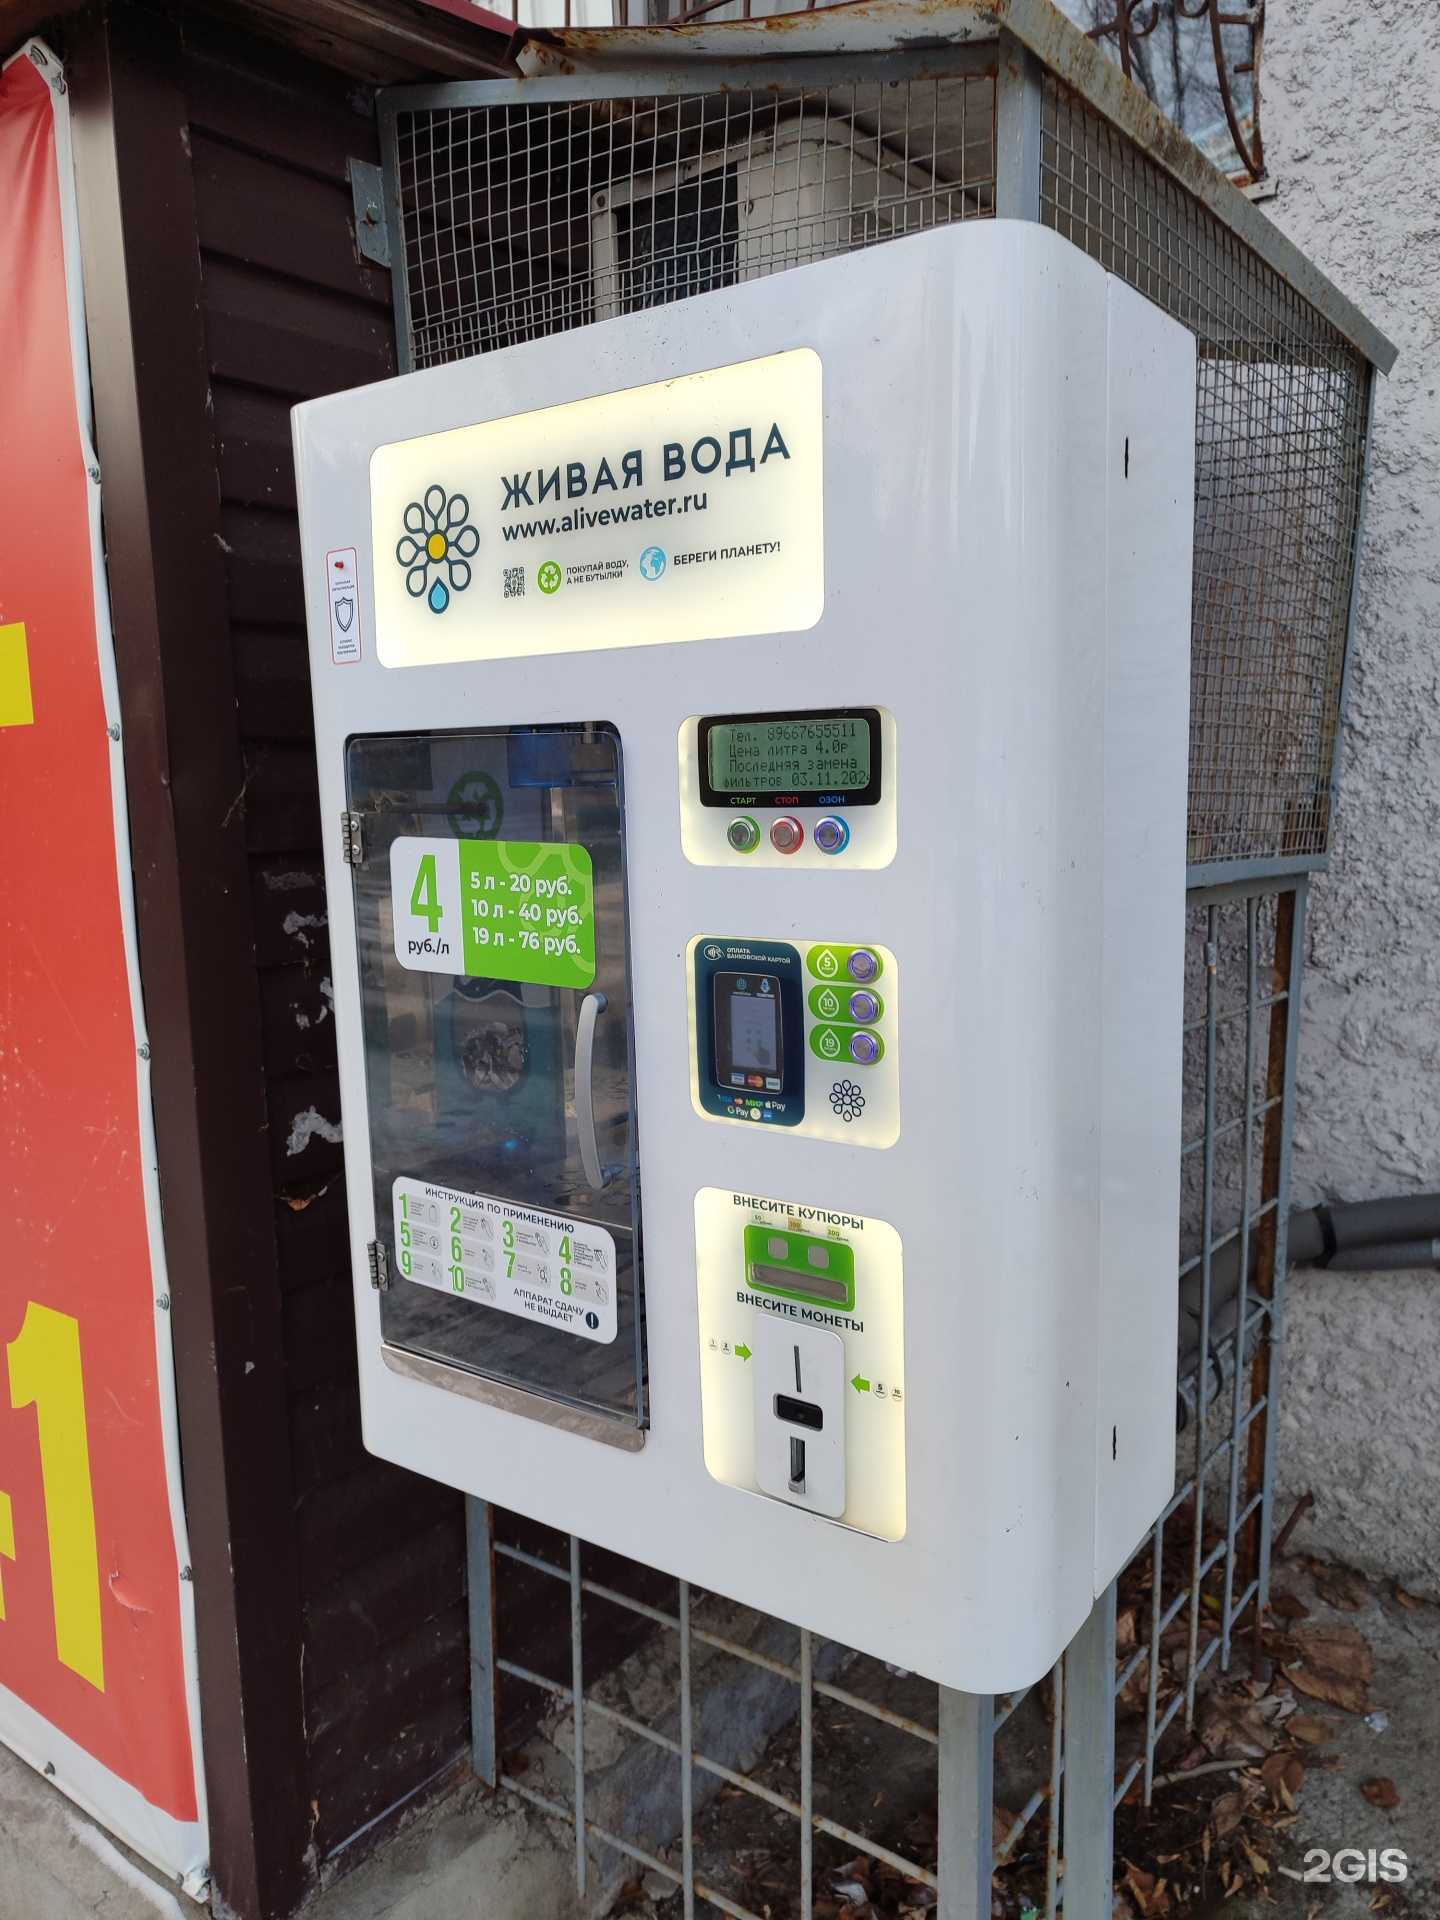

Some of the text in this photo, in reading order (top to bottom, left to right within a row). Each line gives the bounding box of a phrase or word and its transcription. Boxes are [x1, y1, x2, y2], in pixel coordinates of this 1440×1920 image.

[500, 422, 791, 511] ЖИВАЯ ВОДА
[502, 490, 709, 542] www.alivewater.ru
[673, 540, 781, 567] БЕРЕГИ ПЛАНЕТУ!
[566, 559, 629, 575] ПОКУПАЙ ВОДУ,
[566, 570, 623, 585] А НЕ БУТЫЛКИ
[729, 723, 856, 743] Тел. 89667655511
[729, 739, 848, 759] Цена литра 4.0р
[729, 758, 858, 774] Последняя замена
[730, 795, 845, 806] СТАРТ СТОП ОЗОН
[410, 854, 444, 934] 4
[470, 872, 481, 890] 5
[484, 876, 495, 891] л
[509, 874, 531, 893] 20
[535, 875, 572, 898] руб.
[471, 899, 489, 918] 10
[493, 904, 504, 919] л
[518, 903, 542, 922] 40
[546, 905, 583, 928] руб.
[407, 937, 450, 956] руб./л
[472, 927, 490, 945] 19
[493, 932, 504, 946] л
[518, 931, 540, 950] 76
[544, 935, 581, 957] руб.
[726, 947, 751, 955] ОПЛАТА
[726, 953, 791, 964] БАНКОВСКОЙ КАРТОЙ
[823, 957, 831, 967] 5
[823, 998, 834, 1007] 10
[824, 1038, 835, 1048] 19
[736, 1106, 749, 1118] Pay
[772, 1101, 786, 1112] Pay
[399, 1193, 408, 1219] 1
[425, 1187, 484, 1210] ИНСТРУКЦИЯ
[487, 1202, 501, 1214] ПО
[503, 1207, 575, 1234] ПРИМЕНЕНИЮ
[733, 1194, 865, 1231] ВНЕСИТЕ КУПЮРЫ
[450, 1206, 461, 1234] 2
[400, 1221, 411, 1247] 5
[502, 1220, 514, 1248] 3
[451, 1236, 462, 1262] 6
[559, 1235, 572, 1264] 4
[401, 1250, 412, 1276] 9
[503, 1249, 516, 1278] 7
[448, 1265, 465, 1292] 10
[560, 1267, 573, 1296] 8
[513, 1287, 585, 1316] АППАРАТ СДАЧУ
[524, 1301, 574, 1323] НЕ ВЫДАЕТ
[736, 1291, 865, 1333] ВНЕСИТЕ МОНЕТЫ
